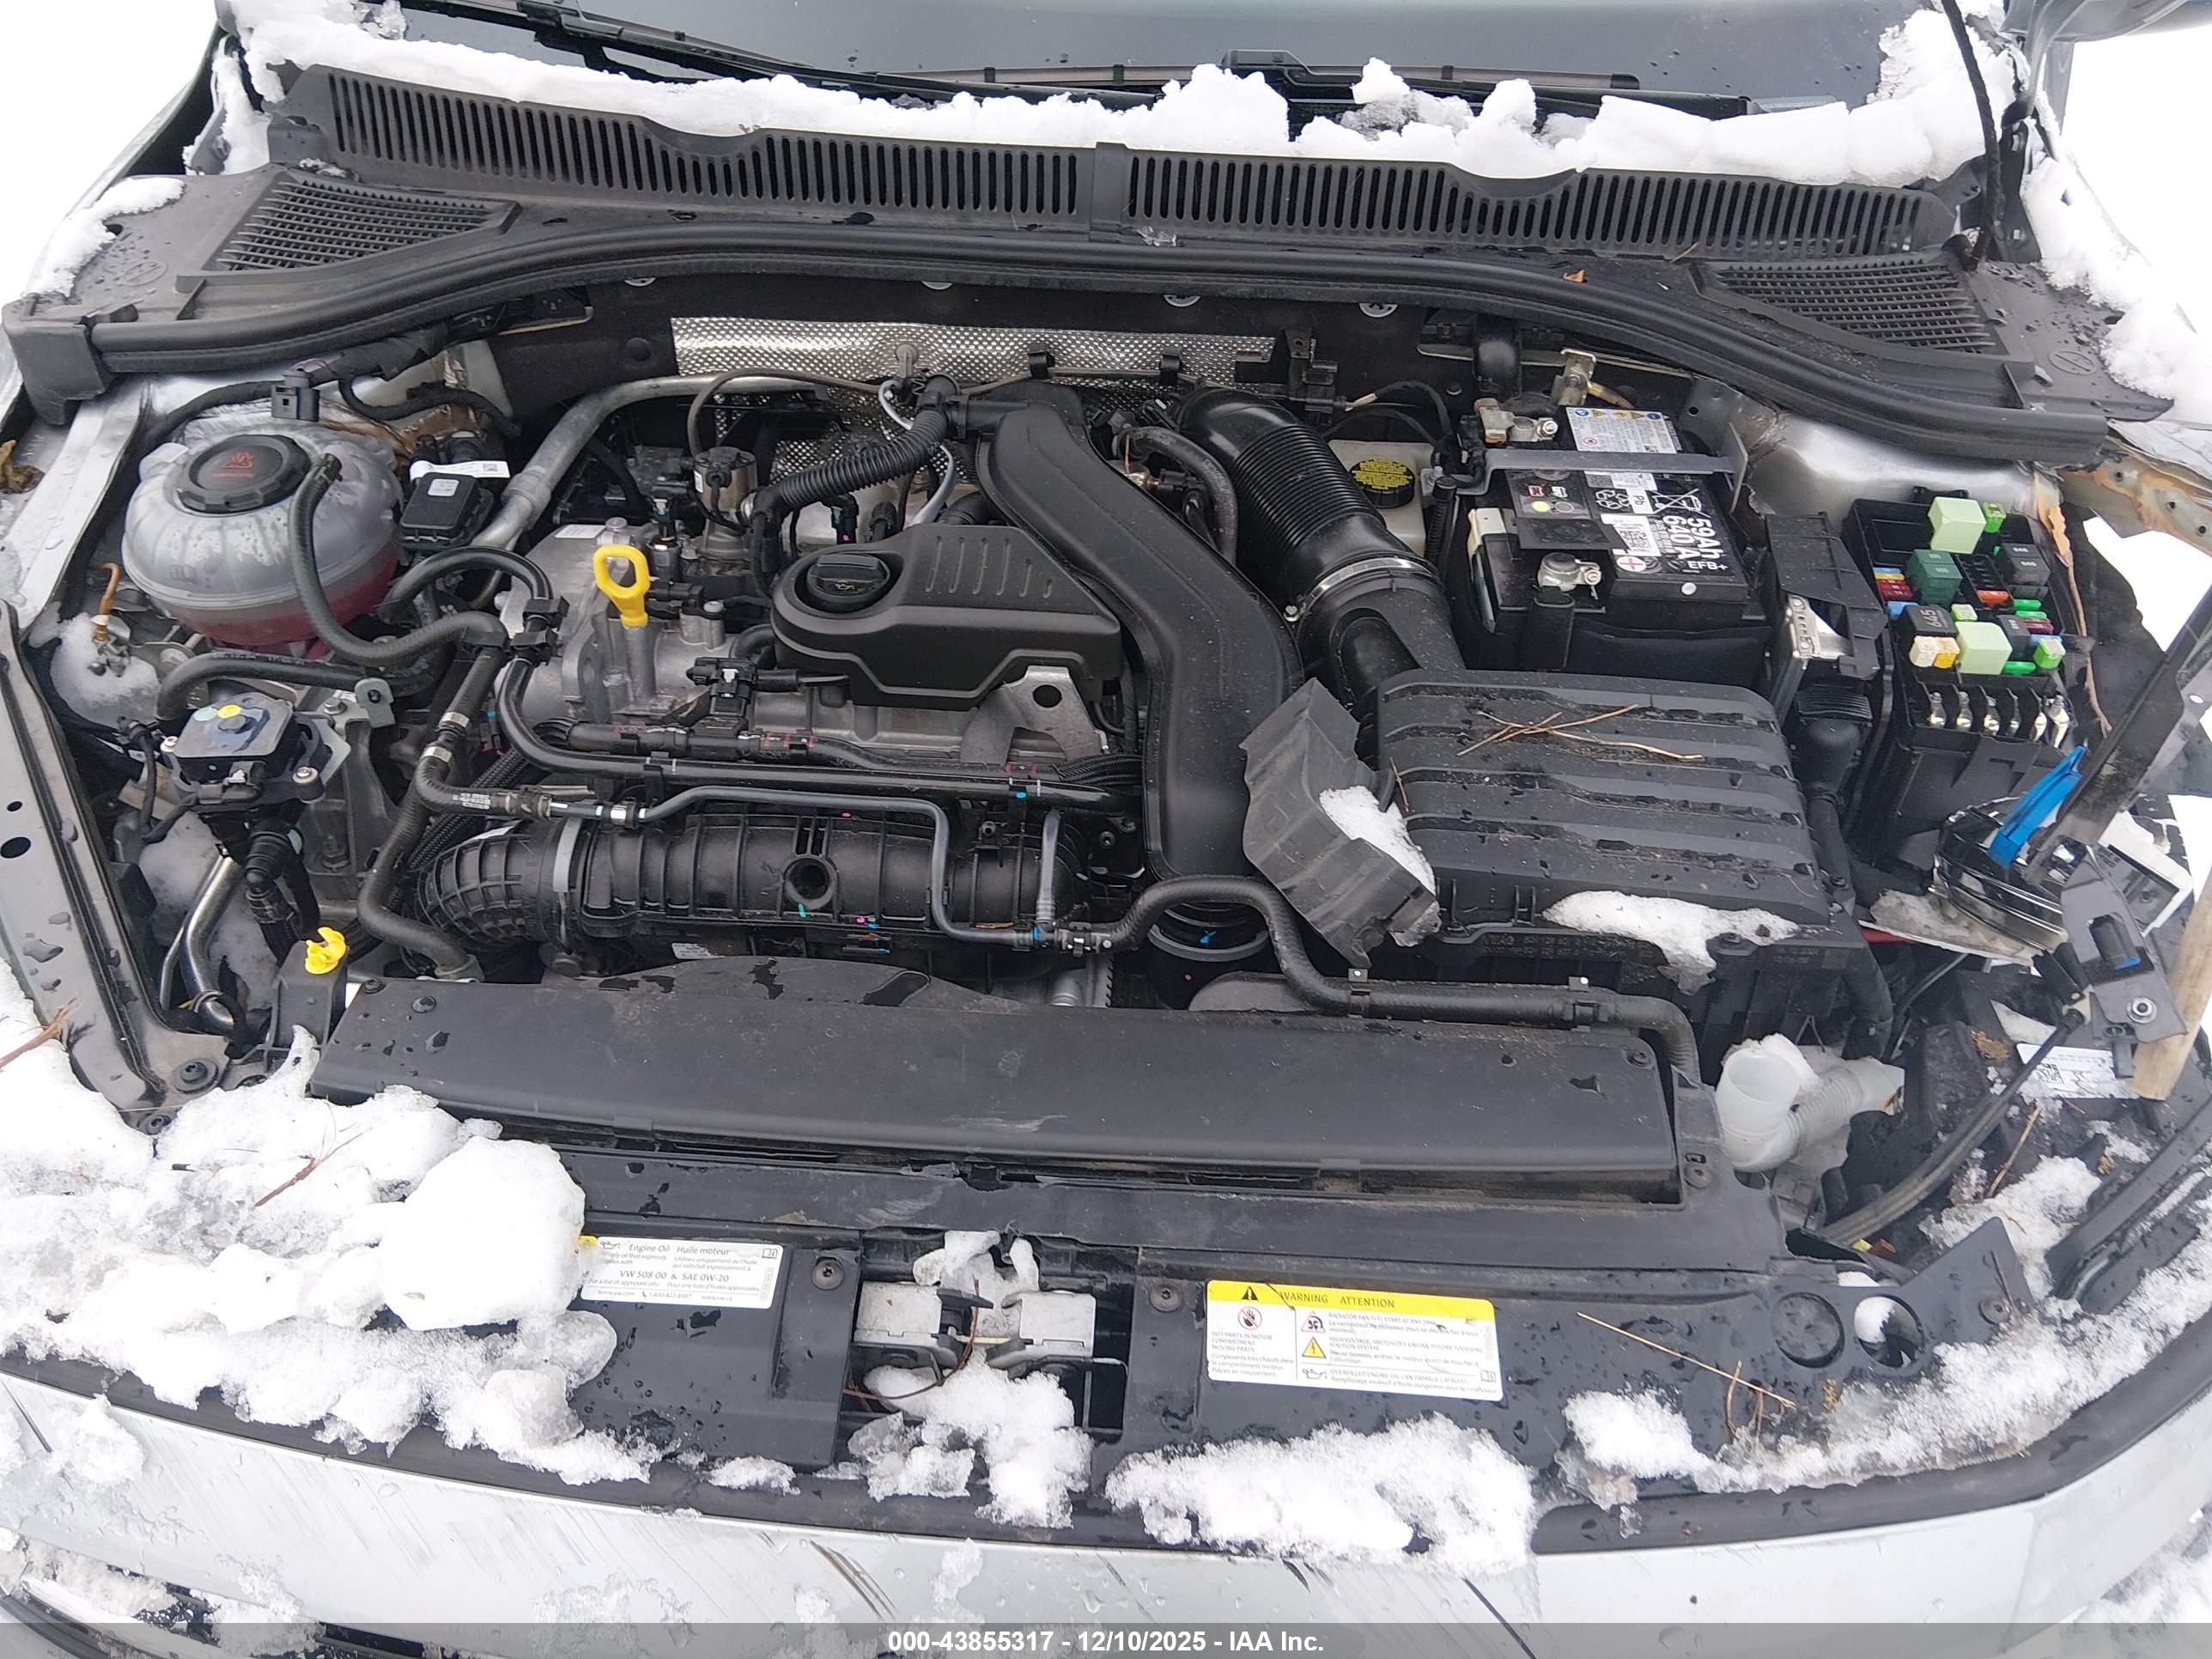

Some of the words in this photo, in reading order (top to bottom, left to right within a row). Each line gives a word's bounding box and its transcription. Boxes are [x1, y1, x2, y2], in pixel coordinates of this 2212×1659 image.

[1662, 515, 1695, 544] 640
[1688, 518, 1724, 560] 59Ah
[1675, 547, 1701, 560] A
[1686, 561, 1730, 572] EFB+
[629, 1243, 657, 1253] Engine
[700, 1273, 729, 1282] 0W-20
[1279, 1291, 1328, 1304] WARNING
[1340, 1295, 1395, 1309] ATTENTION
